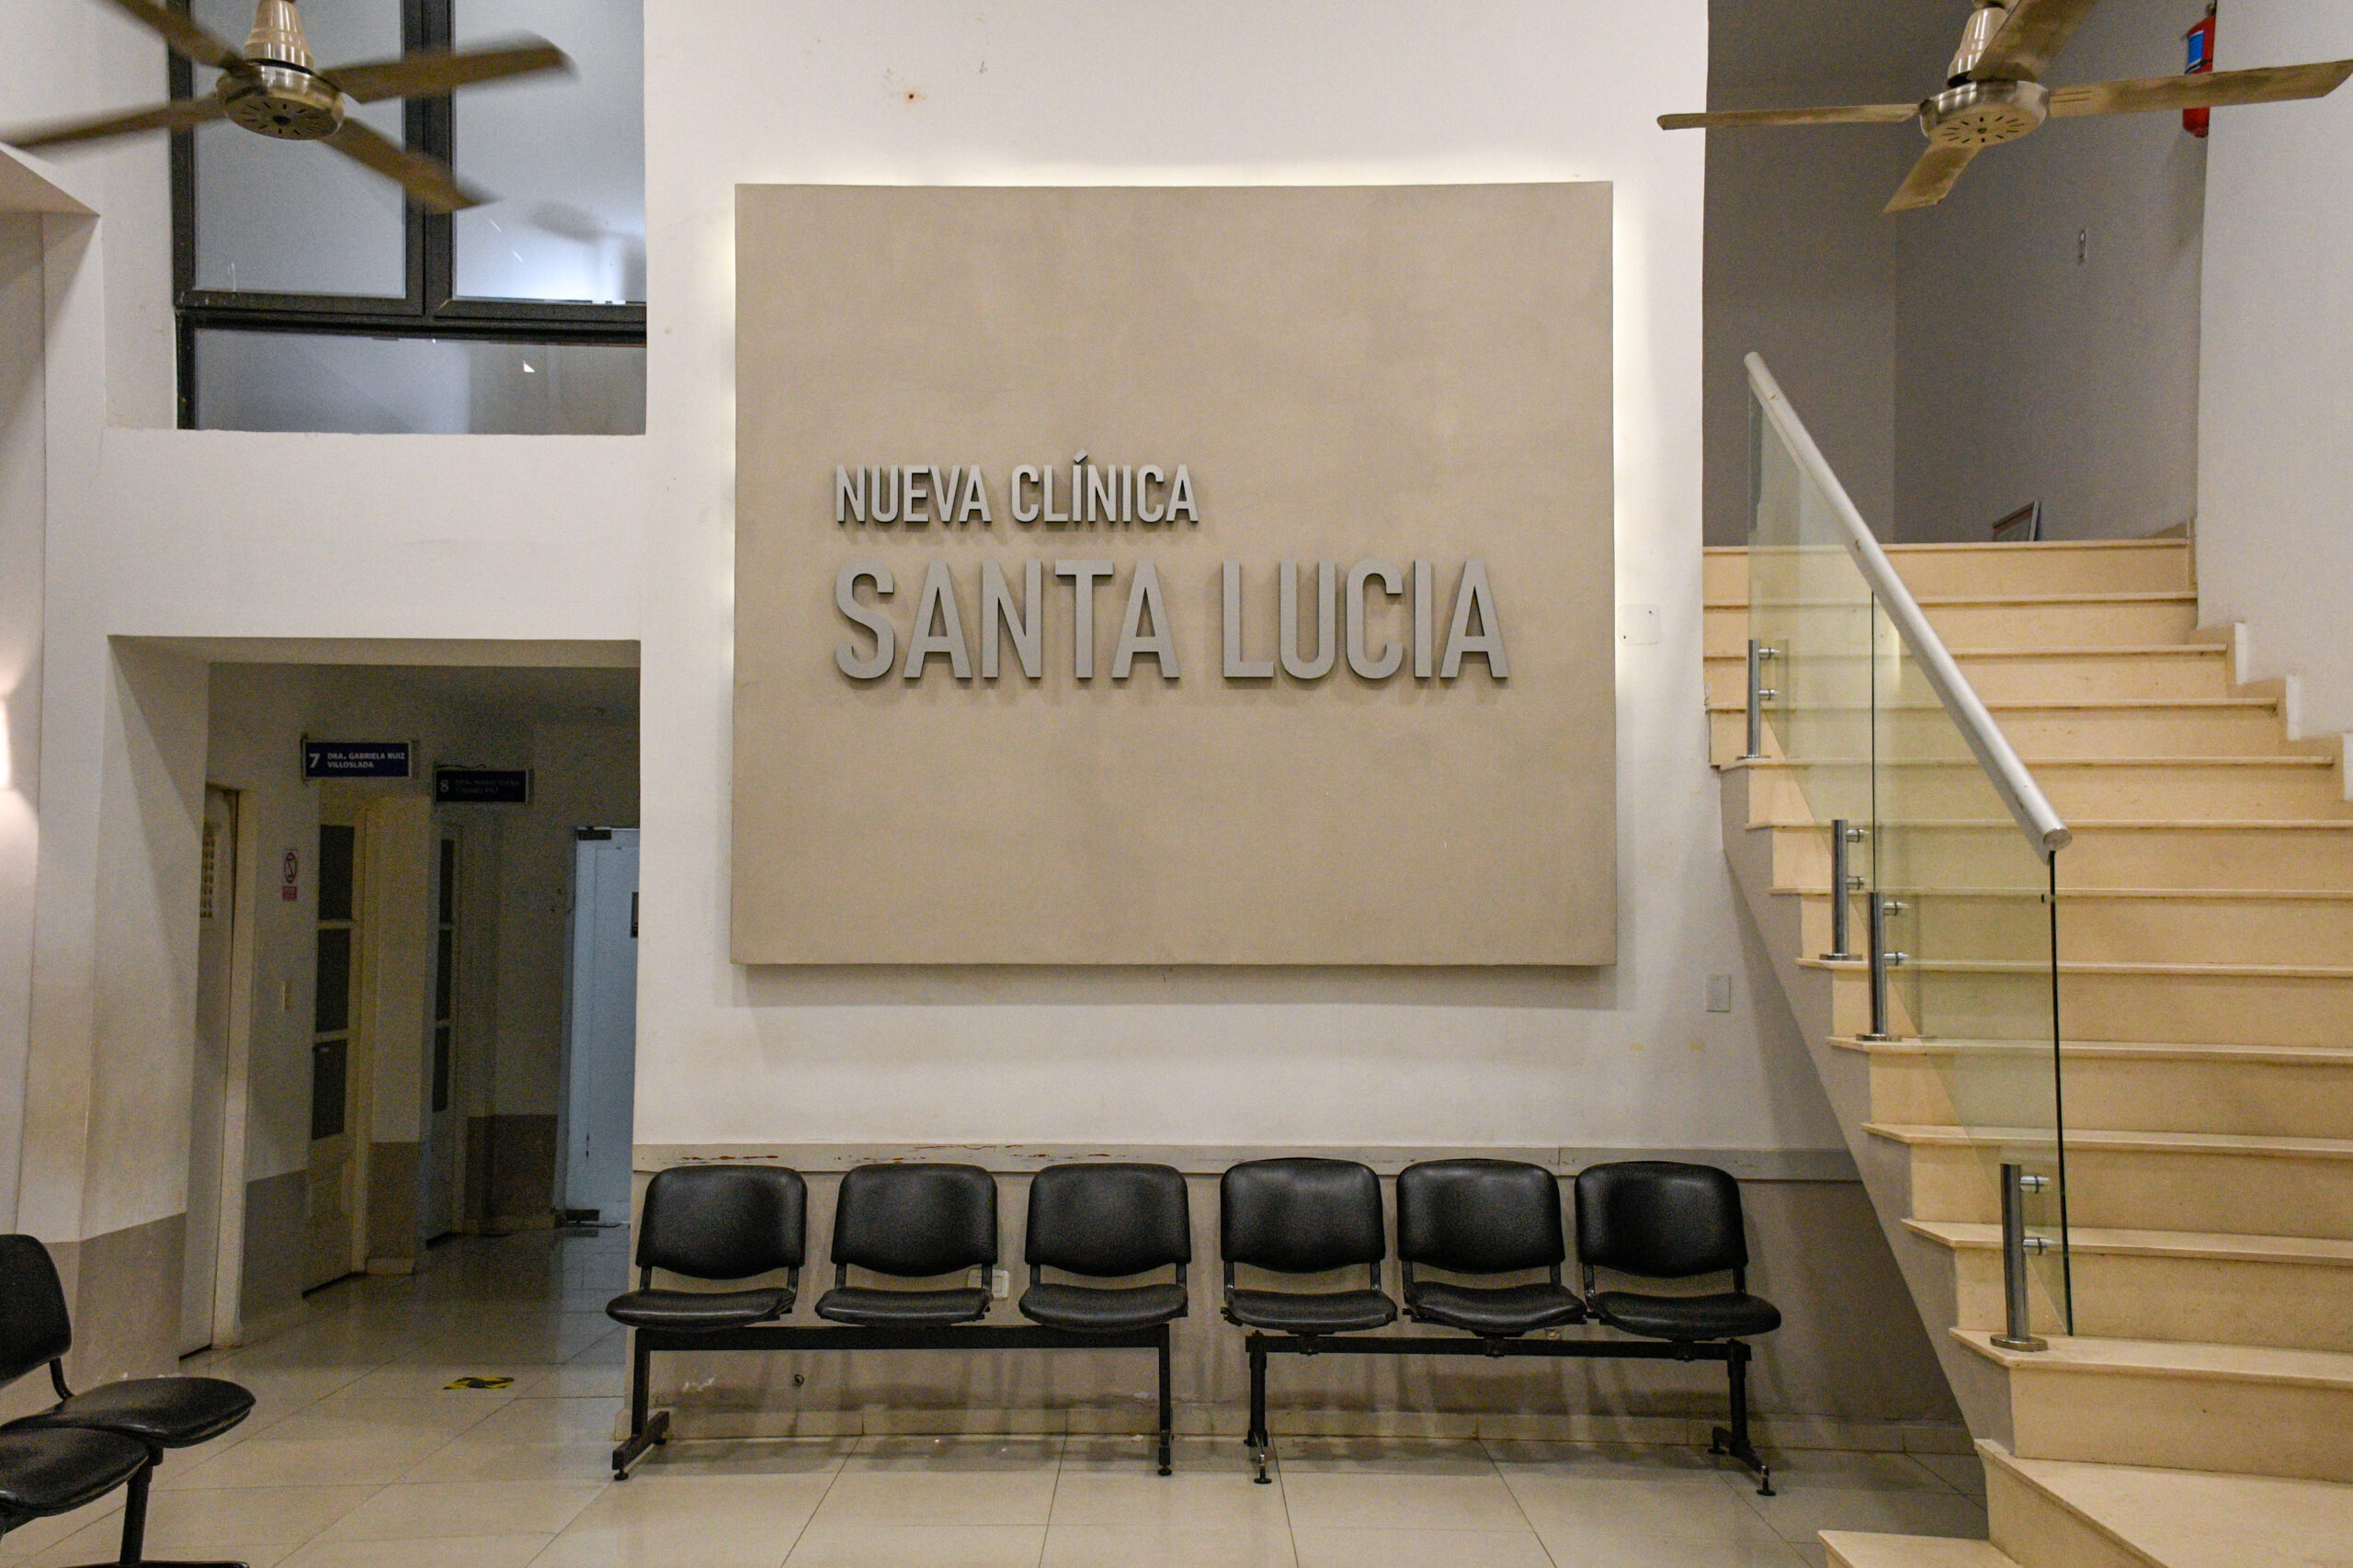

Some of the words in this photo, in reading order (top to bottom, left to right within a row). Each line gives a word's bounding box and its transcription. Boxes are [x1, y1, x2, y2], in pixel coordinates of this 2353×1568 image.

[835, 462, 993, 524] NUEVA
[1009, 447, 1199, 524] CLÍNICA
[835, 557, 1181, 681] SANTA
[1222, 557, 1510, 681] LUCIA
[308, 752, 321, 768] 7
[326, 752, 347, 760] DRA.
[348, 752, 386, 760] GABRIELA
[387, 752, 405, 760] RUIZ
[439, 778, 449, 793] 8
